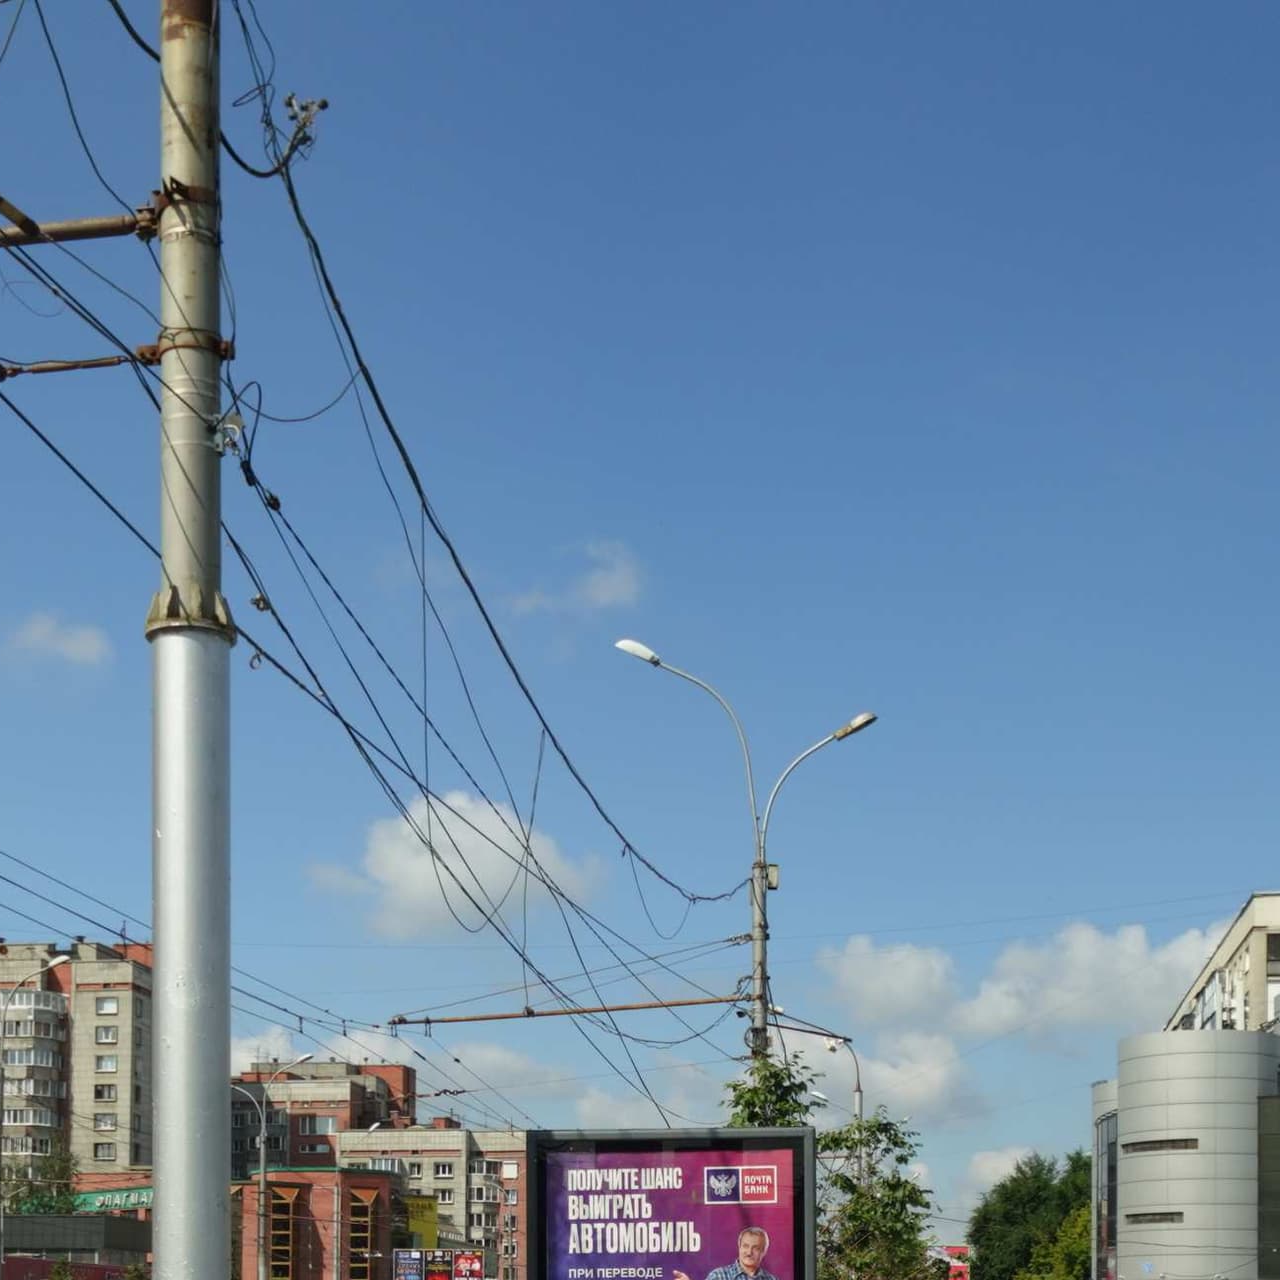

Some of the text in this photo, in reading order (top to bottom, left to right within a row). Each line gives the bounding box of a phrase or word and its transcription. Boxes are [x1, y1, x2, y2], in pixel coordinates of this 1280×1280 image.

[567, 1167, 683, 1191] ПОЛУЧИТЕ ШАНС
[744, 1176, 772, 1185] ПОЧТА
[744, 1185, 769, 1194] БАНК
[95, 1191, 154, 1206] ФЛАГМА
[568, 1194, 653, 1220] ВЫИГРАТЬ
[568, 1221, 701, 1254] АВТОМОБИЛЬ
[568, 1267, 664, 1279] ПРИ ПЕРЕВОДЕ
